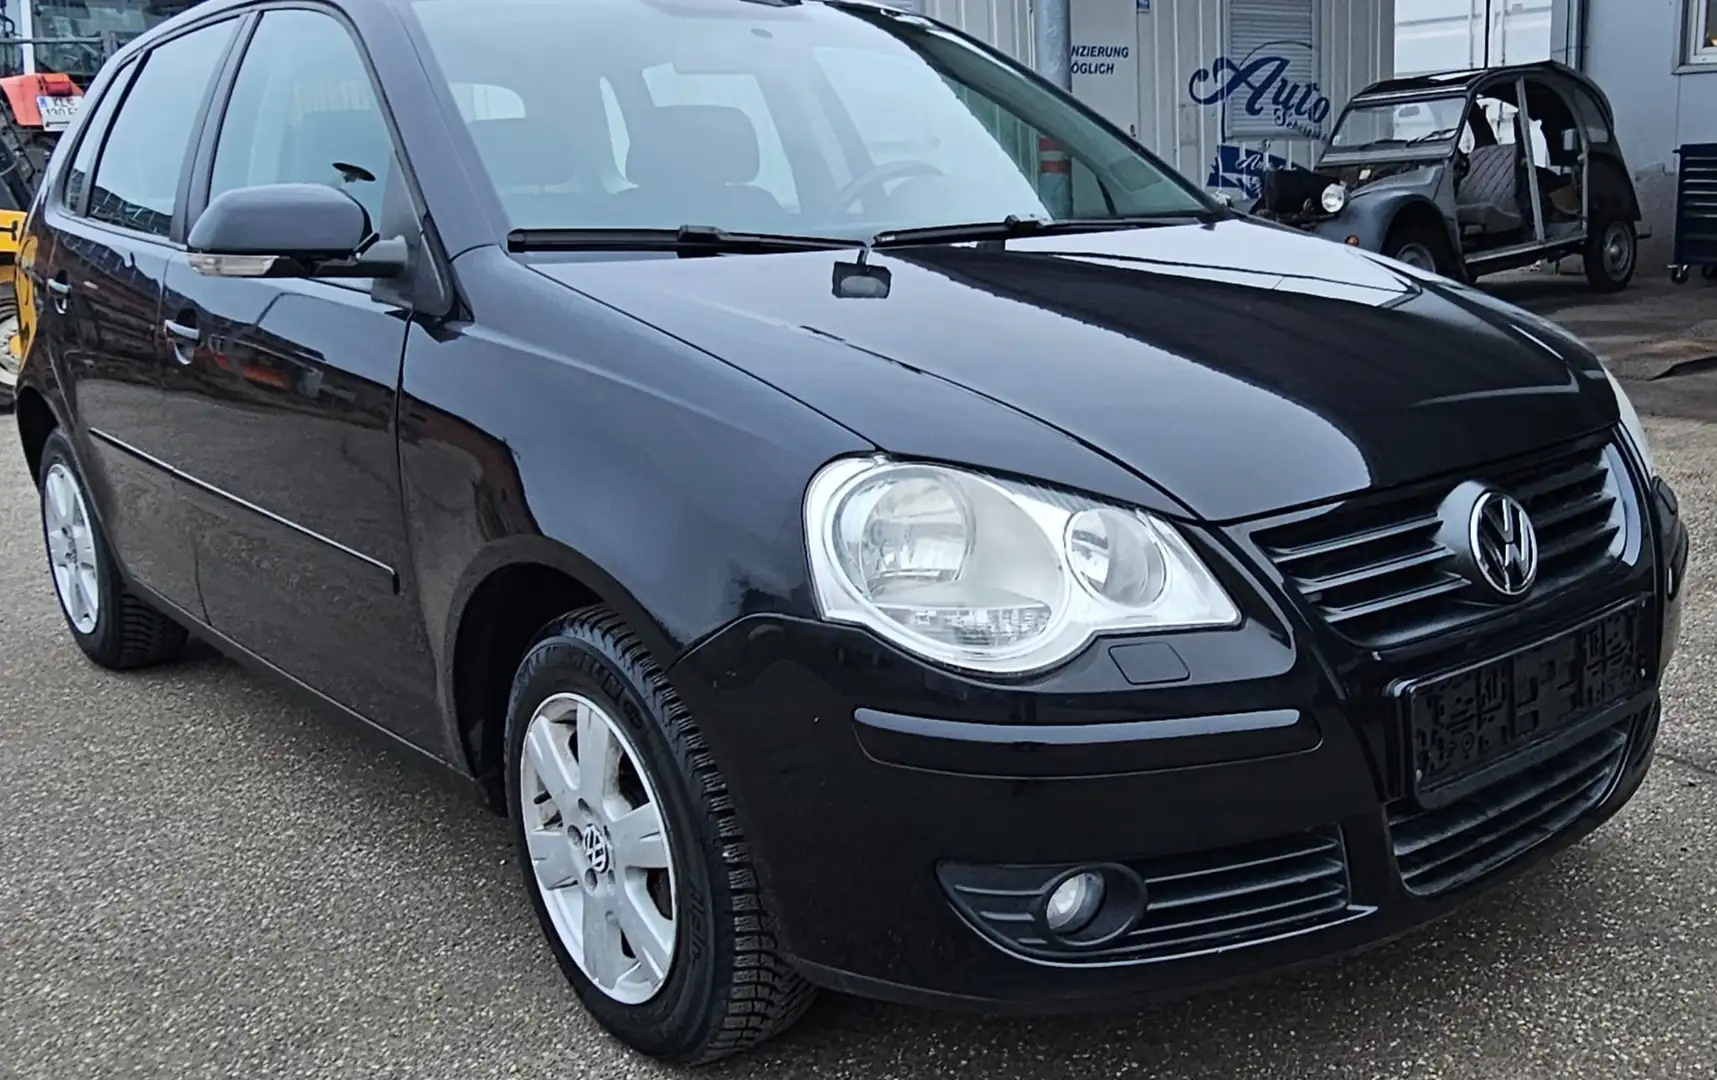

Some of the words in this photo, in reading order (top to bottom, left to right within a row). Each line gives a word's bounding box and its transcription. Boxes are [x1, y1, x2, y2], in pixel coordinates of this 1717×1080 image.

[1070, 46, 1129, 59] NZIERUNG
[1070, 61, 1115, 75] ÖGLICH
[1189, 56, 1330, 123] Auto
